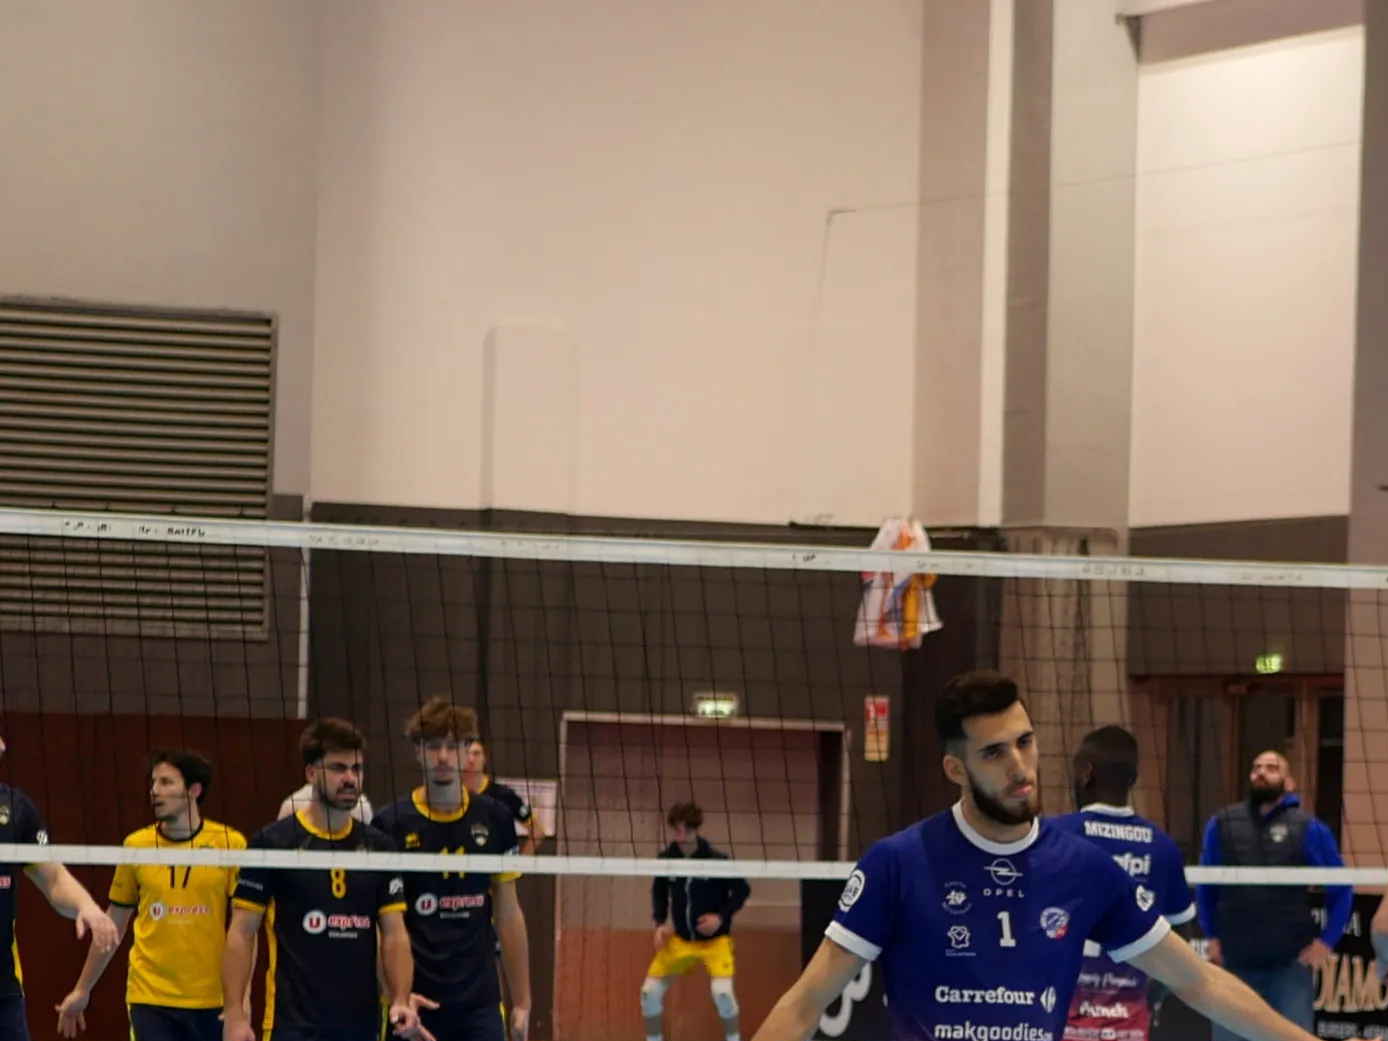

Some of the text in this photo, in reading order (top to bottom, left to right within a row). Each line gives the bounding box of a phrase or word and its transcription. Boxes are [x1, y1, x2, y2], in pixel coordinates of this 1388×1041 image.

[330, 868, 348, 898] 8
[983, 888, 1026, 898] OPEL
[996, 911, 1017, 948] 1
[934, 985, 1036, 1005] Carrefour
